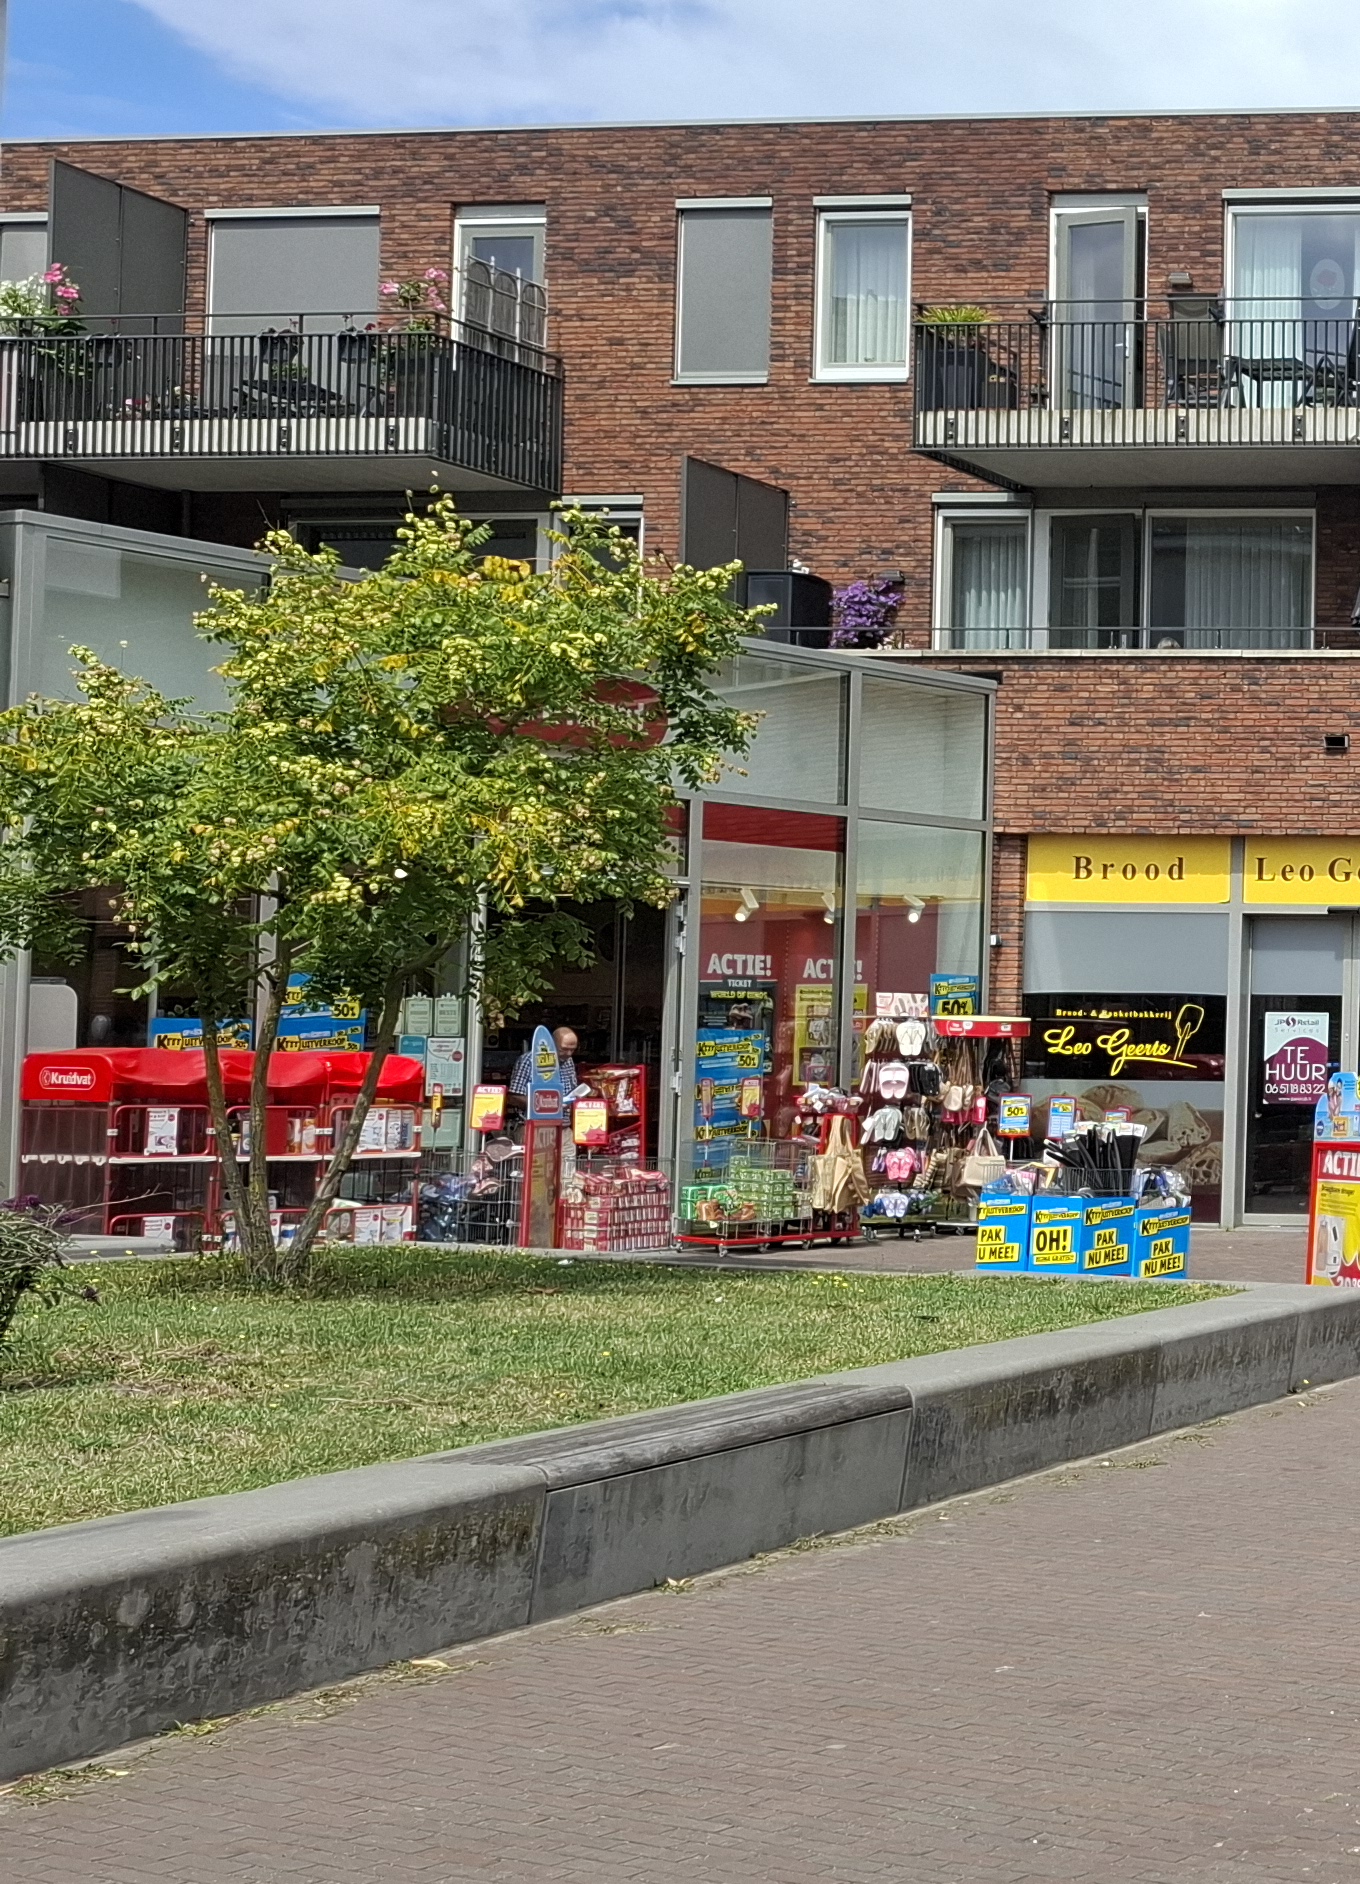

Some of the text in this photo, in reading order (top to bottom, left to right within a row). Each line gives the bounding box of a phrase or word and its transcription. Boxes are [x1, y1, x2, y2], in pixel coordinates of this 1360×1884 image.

[1073, 855, 1184, 881] Brood
[1255, 857, 1315, 882] Leo
[707, 953, 772, 976] ACTIE!
[942, 999, 968, 1015] 50%
[1044, 1026, 1172, 1076] Leo Geerts
[1283, 1047, 1309, 1063] TE
[50, 1071, 91, 1086] Kruidvat
[1265, 1063, 1326, 1081] HUUR
[1265, 1083, 1278, 1094] 06
[1313, 1083, 1325, 1094] 22
[1007, 1106, 1024, 1116] 50%
[981, 1228, 1002, 1242] PAK
[1036, 1229, 1068, 1252] OH!
[1096, 1231, 1115, 1246] PAK
[989, 1246, 1014, 1260] MEE!
[1152, 1240, 1171, 1255] PAK
[1088, 1246, 1125, 1266] NU MEE!
[1144, 1256, 1181, 1276] NU MEE!
